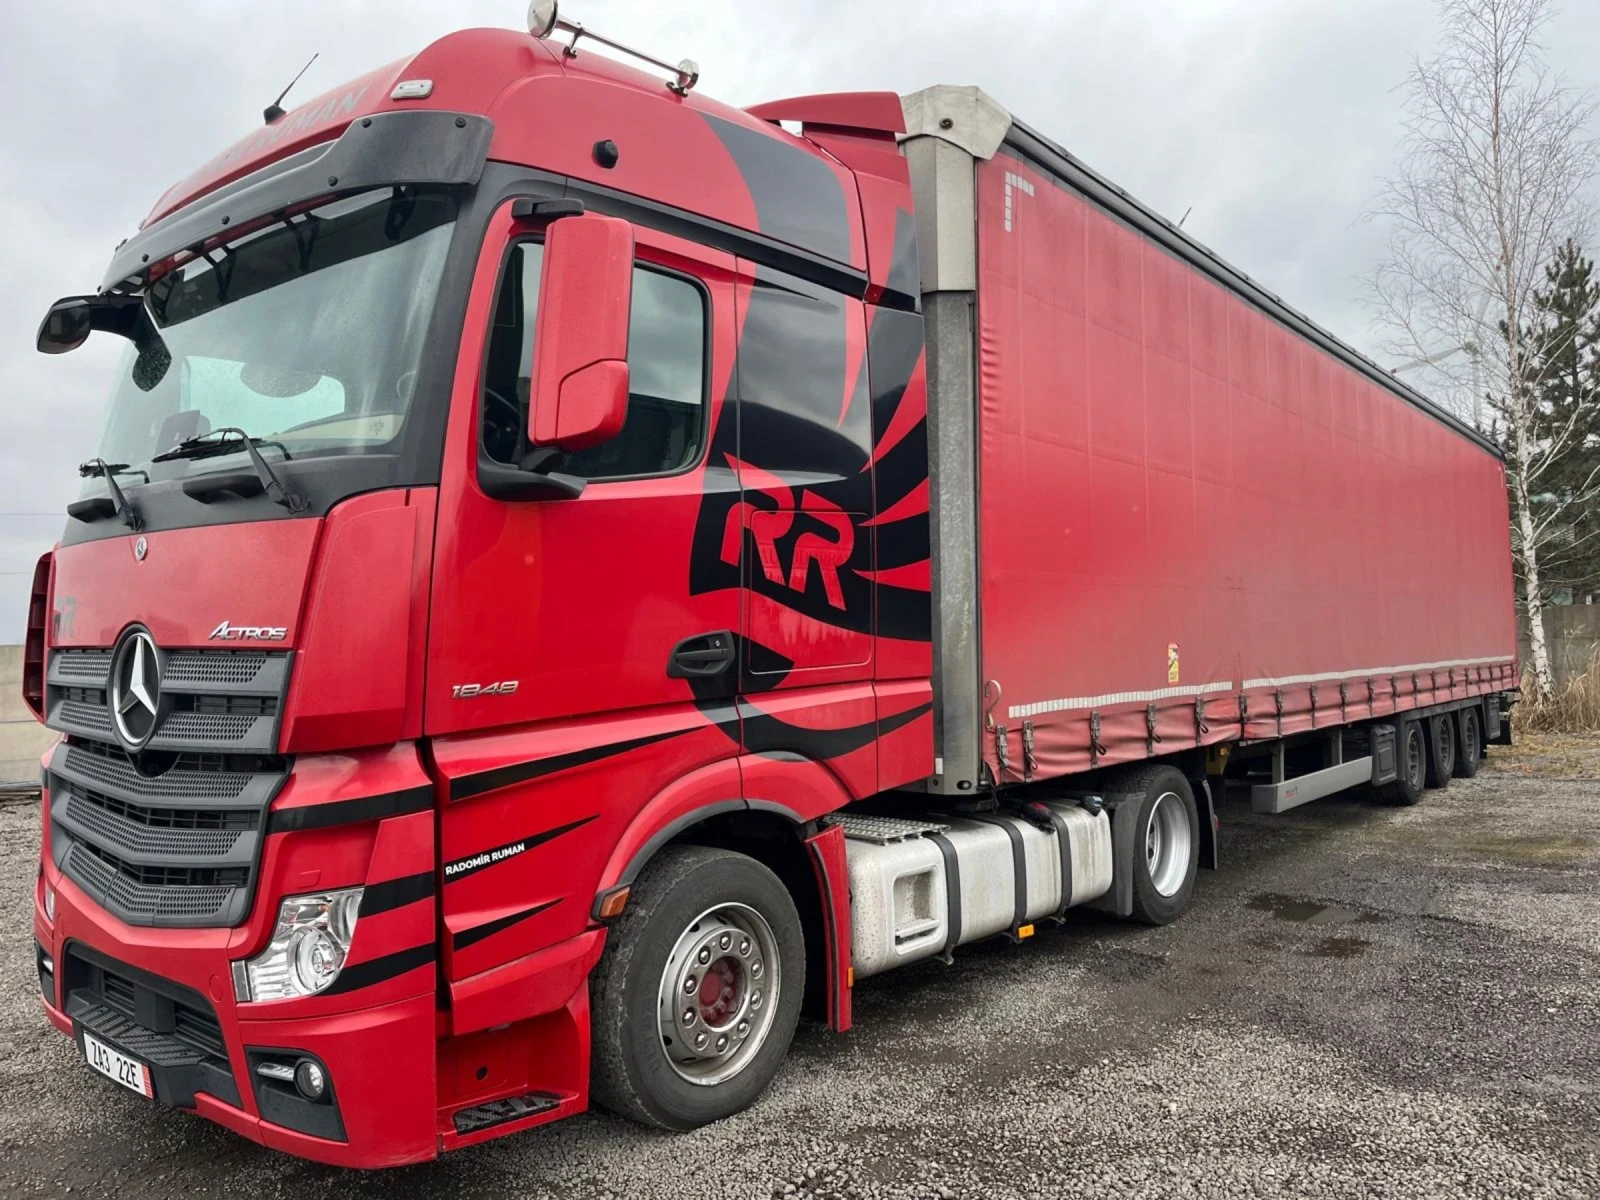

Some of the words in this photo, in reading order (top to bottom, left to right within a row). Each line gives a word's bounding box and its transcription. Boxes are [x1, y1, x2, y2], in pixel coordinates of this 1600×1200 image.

[207, 620, 288, 641] ACTROS
[452, 680, 519, 699] 1848
[445, 854, 490, 875] RADOMÍR
[491, 843, 524, 861] RUMAN
[91, 1041, 110, 1073] ZA3
[116, 1056, 140, 1089] 22E
